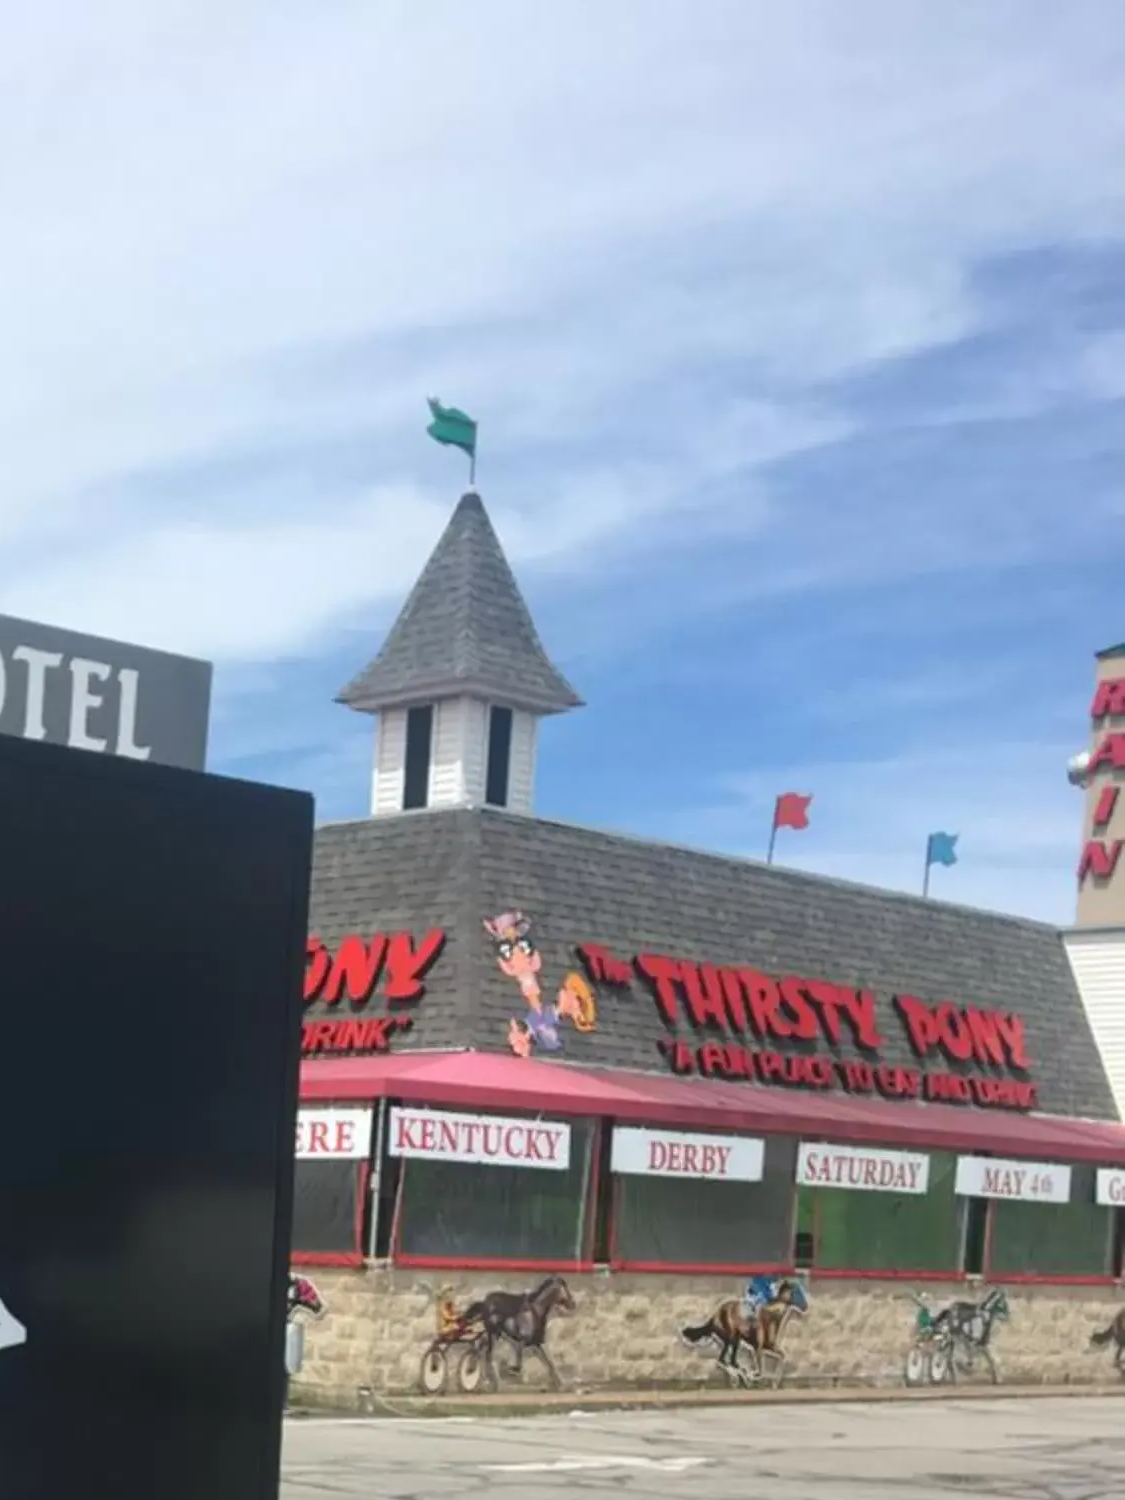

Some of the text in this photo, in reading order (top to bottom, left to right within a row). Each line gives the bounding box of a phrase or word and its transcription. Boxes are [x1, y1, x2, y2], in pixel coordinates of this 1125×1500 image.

[638, 953, 886, 1047] THIRSTY
[899, 994, 1031, 1069] PONY
[396, 1115, 563, 1161] KENTUCKY
[648, 1140, 733, 1175] DERBY
[804, 1152, 922, 1189] SATURDAY
[981, 1166, 1026, 1196] MAY
